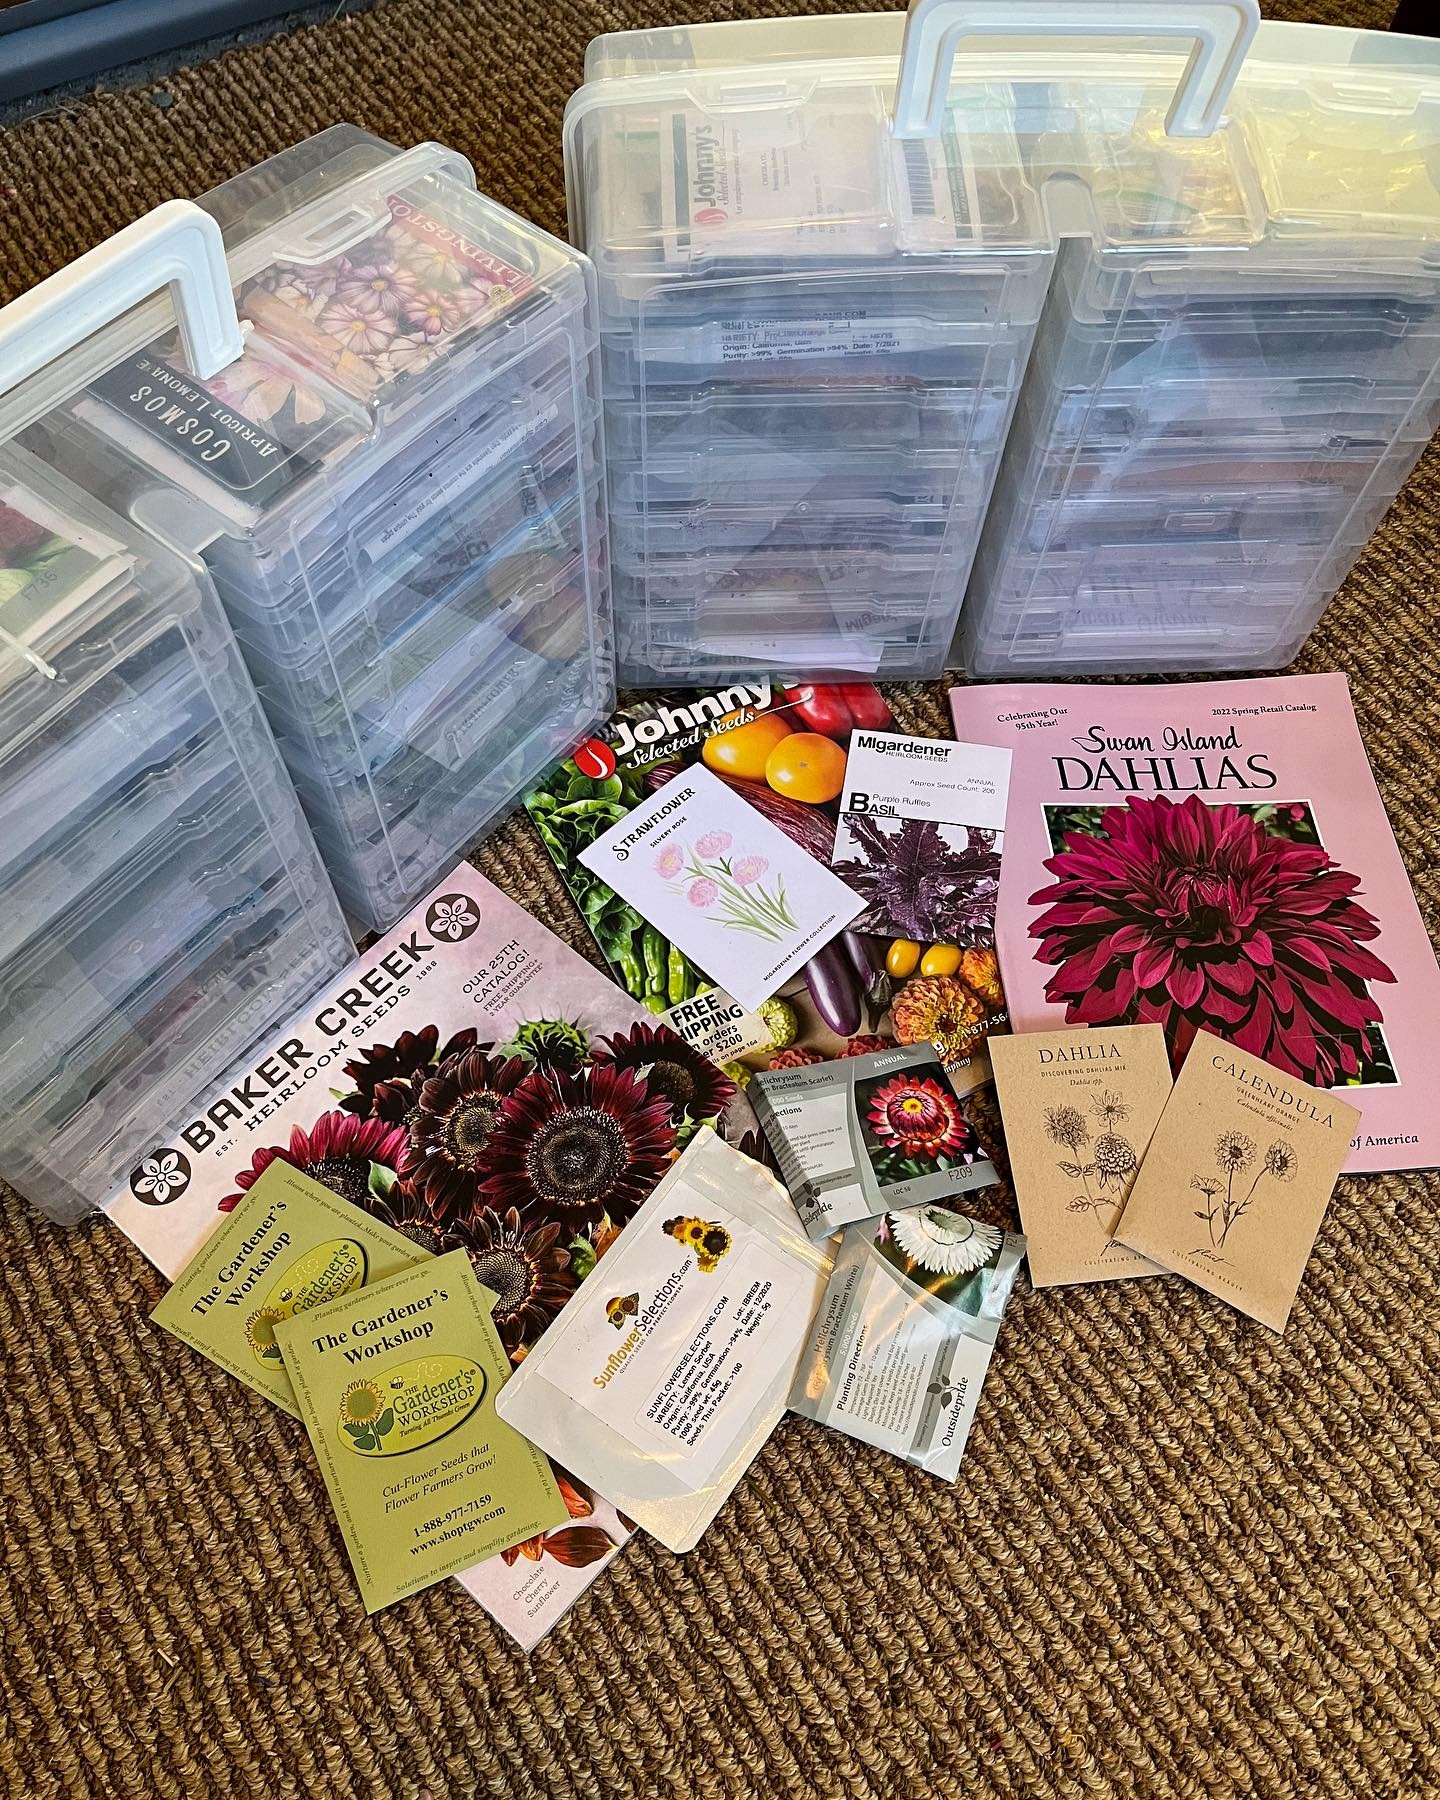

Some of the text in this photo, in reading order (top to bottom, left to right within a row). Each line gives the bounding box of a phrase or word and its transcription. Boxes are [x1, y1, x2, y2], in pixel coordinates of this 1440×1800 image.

[694, 124, 719, 207] Johnny's
[130, 386, 231, 461] COSMOS
[136, 359, 278, 457] APRICOT LEMONAE
[997, 706, 1069, 724] Celebrating Our
[1015, 718, 1059, 731] 95th Year!
[1211, 703, 1317, 718] 2022 Spring Retail Catalog
[626, 708, 755, 770] Selected Seeds
[857, 736, 951, 757] MIgardener
[886, 751, 948, 763] HEIRLOOM SEEDS
[1071, 725, 1243, 753] Swan Island
[910, 779, 935, 787] Approx
[957, 784, 980, 793] Count:
[967, 778, 995, 786] ANNUAL
[1051, 754, 1278, 791] DAHLIAS
[849, 792, 899, 816] BASIL
[872, 794, 931, 807] Purple Ruffles
[612, 788, 696, 861] STRAWFLOWER
[650, 816, 687, 848] SILVERY ROSE
[462, 939, 520, 994] OUR 25TH
[763, 914, 836, 981] MIGARDENER FLOWER COLLECTION
[473, 949, 530, 1003] CATALOG!
[483, 992, 503, 1012] FREE
[492, 997, 509, 1012] YEAR
[669, 993, 721, 1028] FREE
[180, 930, 434, 1154] BAKER CREEK
[678, 1003, 744, 1046] HIPPING
[702, 1025, 738, 1046] orders
[715, 1033, 743, 1052] $200
[960, 1013, 1008, 1038] 1-877-56
[215, 1137, 238, 1157] EST.
[243, 1031, 349, 1132] HEIRLOOM
[351, 985, 411, 1038] SEEDS
[729, 1045, 746, 1056] page
[872, 1052, 907, 1068] ANNUAL
[1038, 1043, 1122, 1065] DAHLIA
[1041, 1068, 1084, 1077] DISCOVERING
[1212, 1055, 1333, 1129] CALENDULA
[1350, 1134, 1419, 1150] of America
[947, 1165, 974, 1182] F209
[190, 1201, 287, 1315] The Gardener's
[224, 1232, 291, 1306] Workshop
[295, 1286, 309, 1300] THE
[829, 1263, 860, 1336] Bracteatum White)
[311, 1289, 449, 1353] The Gardener's
[593, 1259, 693, 1389] SunflowerSelections.com
[619, 1284, 684, 1374] QUALITY SEEDS FOR PERFECT FLOWERS
[813, 1292, 840, 1353] Helichrysum
[342, 1322, 434, 1365] Workshop
[646, 1295, 729, 1419] SUNFLOWERSELECTIONS.COM
[670, 1281, 772, 1436] Purity: >99% Germination >94% Date: 12/2020
[654, 1340, 713, 1424] VARIETY: Lemon Sorbet
[662, 1404, 682, 1430] Origin:
[679, 1370, 706, 1404] California,
[701, 1353, 716, 1369] USA
[732, 1306, 746, 1321] Lot:
[679, 1302, 772, 1440] 1000 seed wt: 45g Weight: 5g
[835, 1371, 856, 1411] Planting
[847, 1323, 870, 1370] Directions
[396, 1385, 475, 1427] WORKSHOP
[403, 1384, 419, 1396] THE
[686, 1362, 743, 1447] Seeds This Packet: >100
[938, 1375, 973, 1448] Outsidepride
[399, 1402, 470, 1438] Turning All Thumbs Green
[382, 1443, 489, 1498] Cut-Flower Seeds that
[385, 1454, 496, 1513] Flower Farmers Grow!
[410, 1506, 506, 1555] www.shoptgw.com
[414, 1494, 491, 1538] 1-888-977-7159
[512, 1566, 545, 1601] Chocolate
[524, 1578, 548, 1604] Cherry
[527, 1580, 560, 1618] Sunflower
